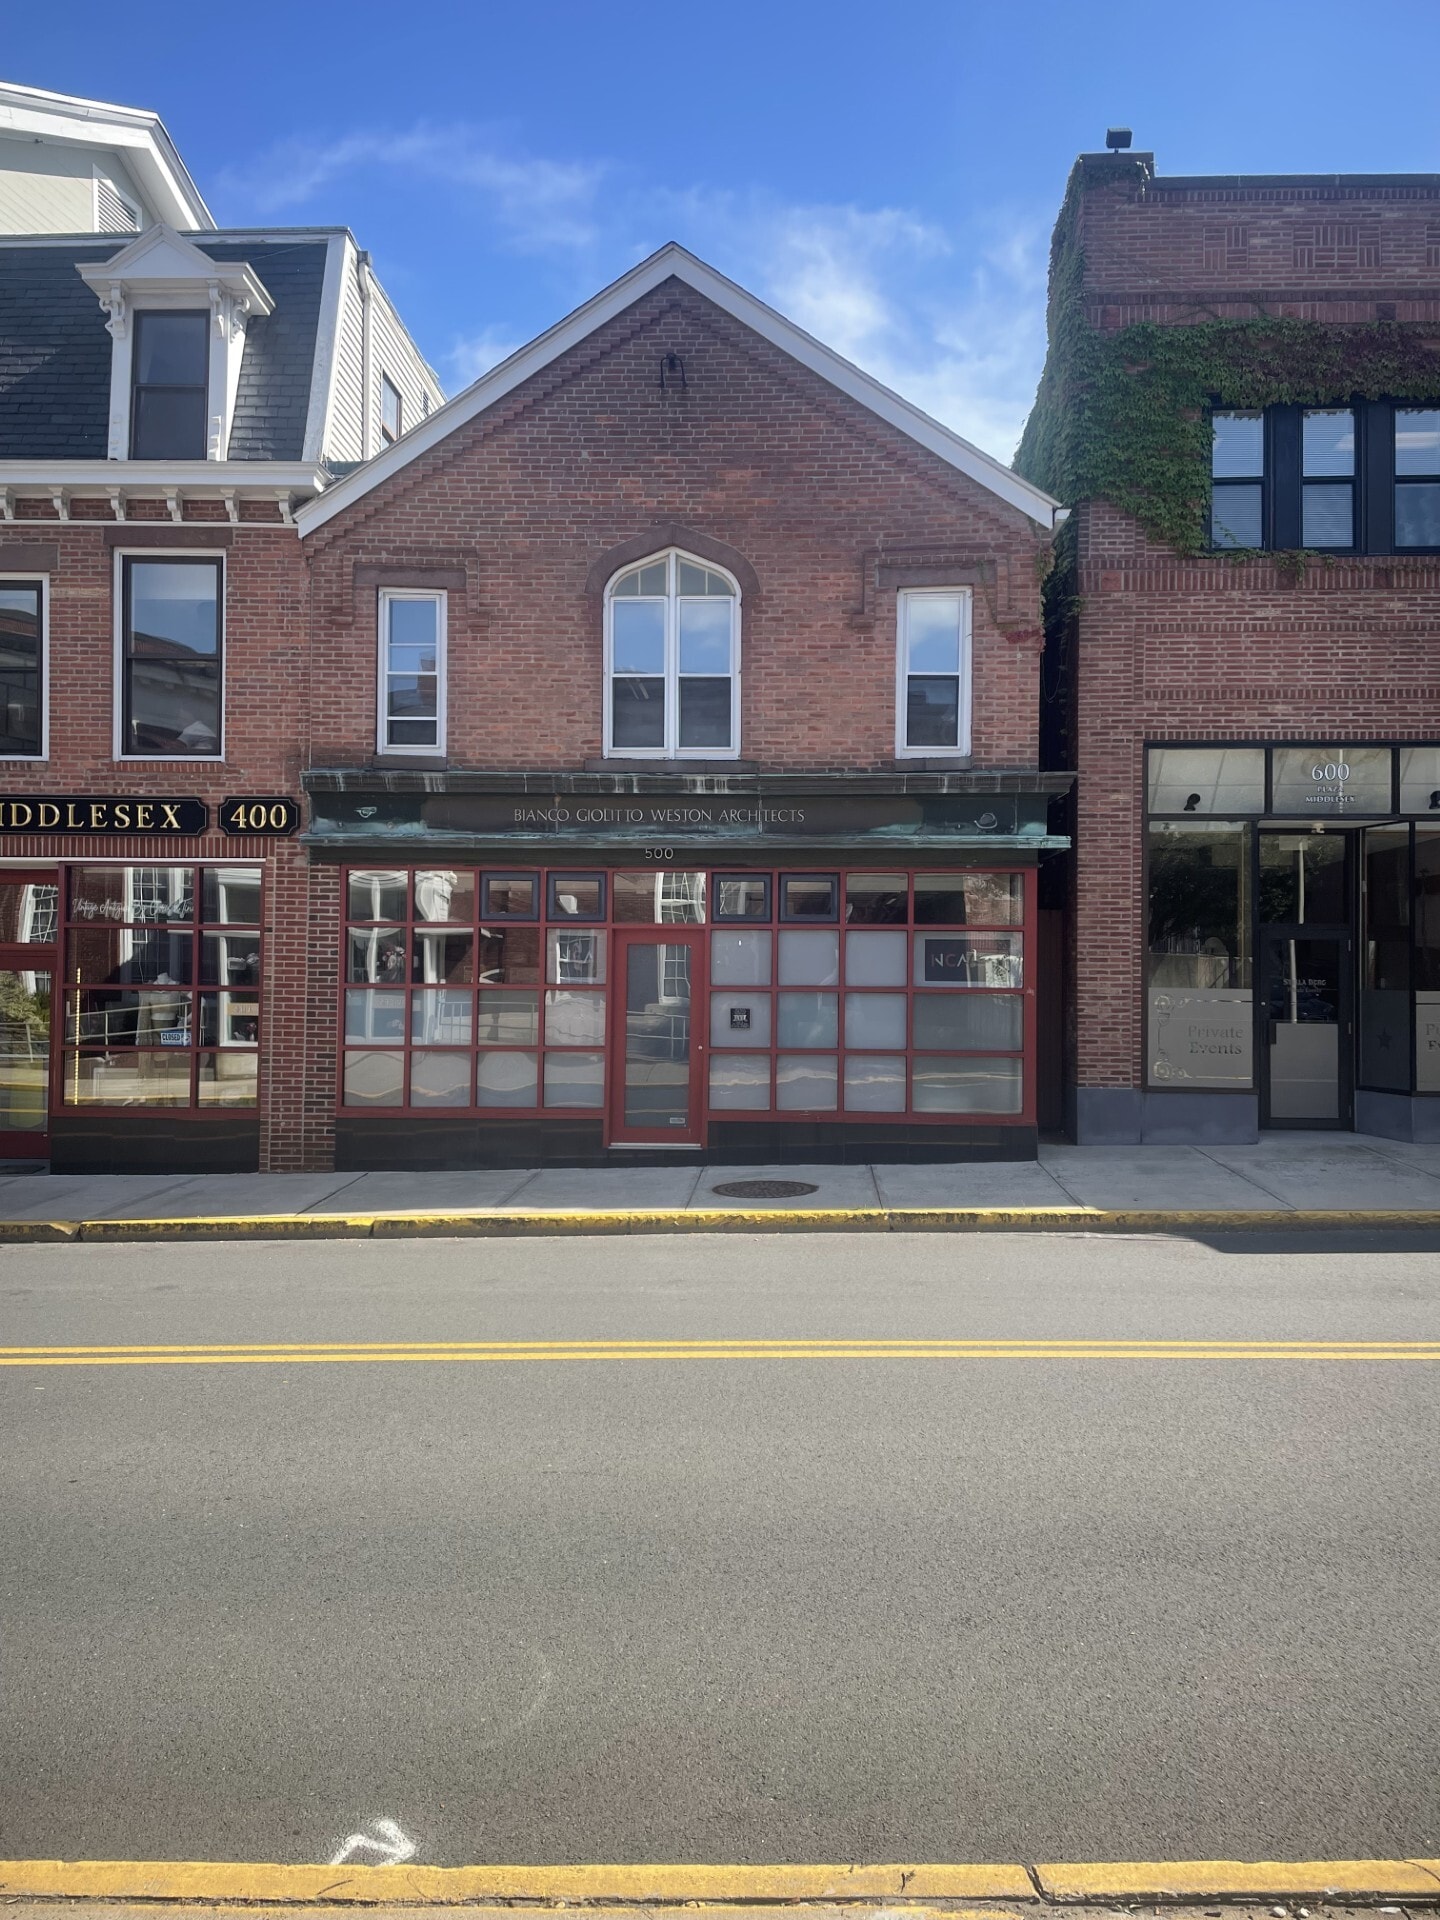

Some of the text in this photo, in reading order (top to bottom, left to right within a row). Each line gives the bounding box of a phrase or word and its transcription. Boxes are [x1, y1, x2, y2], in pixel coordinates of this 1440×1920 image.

[1311, 763, 1350, 781] 600
[230, 804, 288, 829] 400
[514, 808, 805, 823] BIANCO GIOLITTO WESTON ARCHITECTS
[644, 848, 674, 860] 500
[162, 1033, 181, 1041] CLOSED
[1187, 1025, 1244, 1038] Private
[1189, 1041, 1242, 1055] Events
